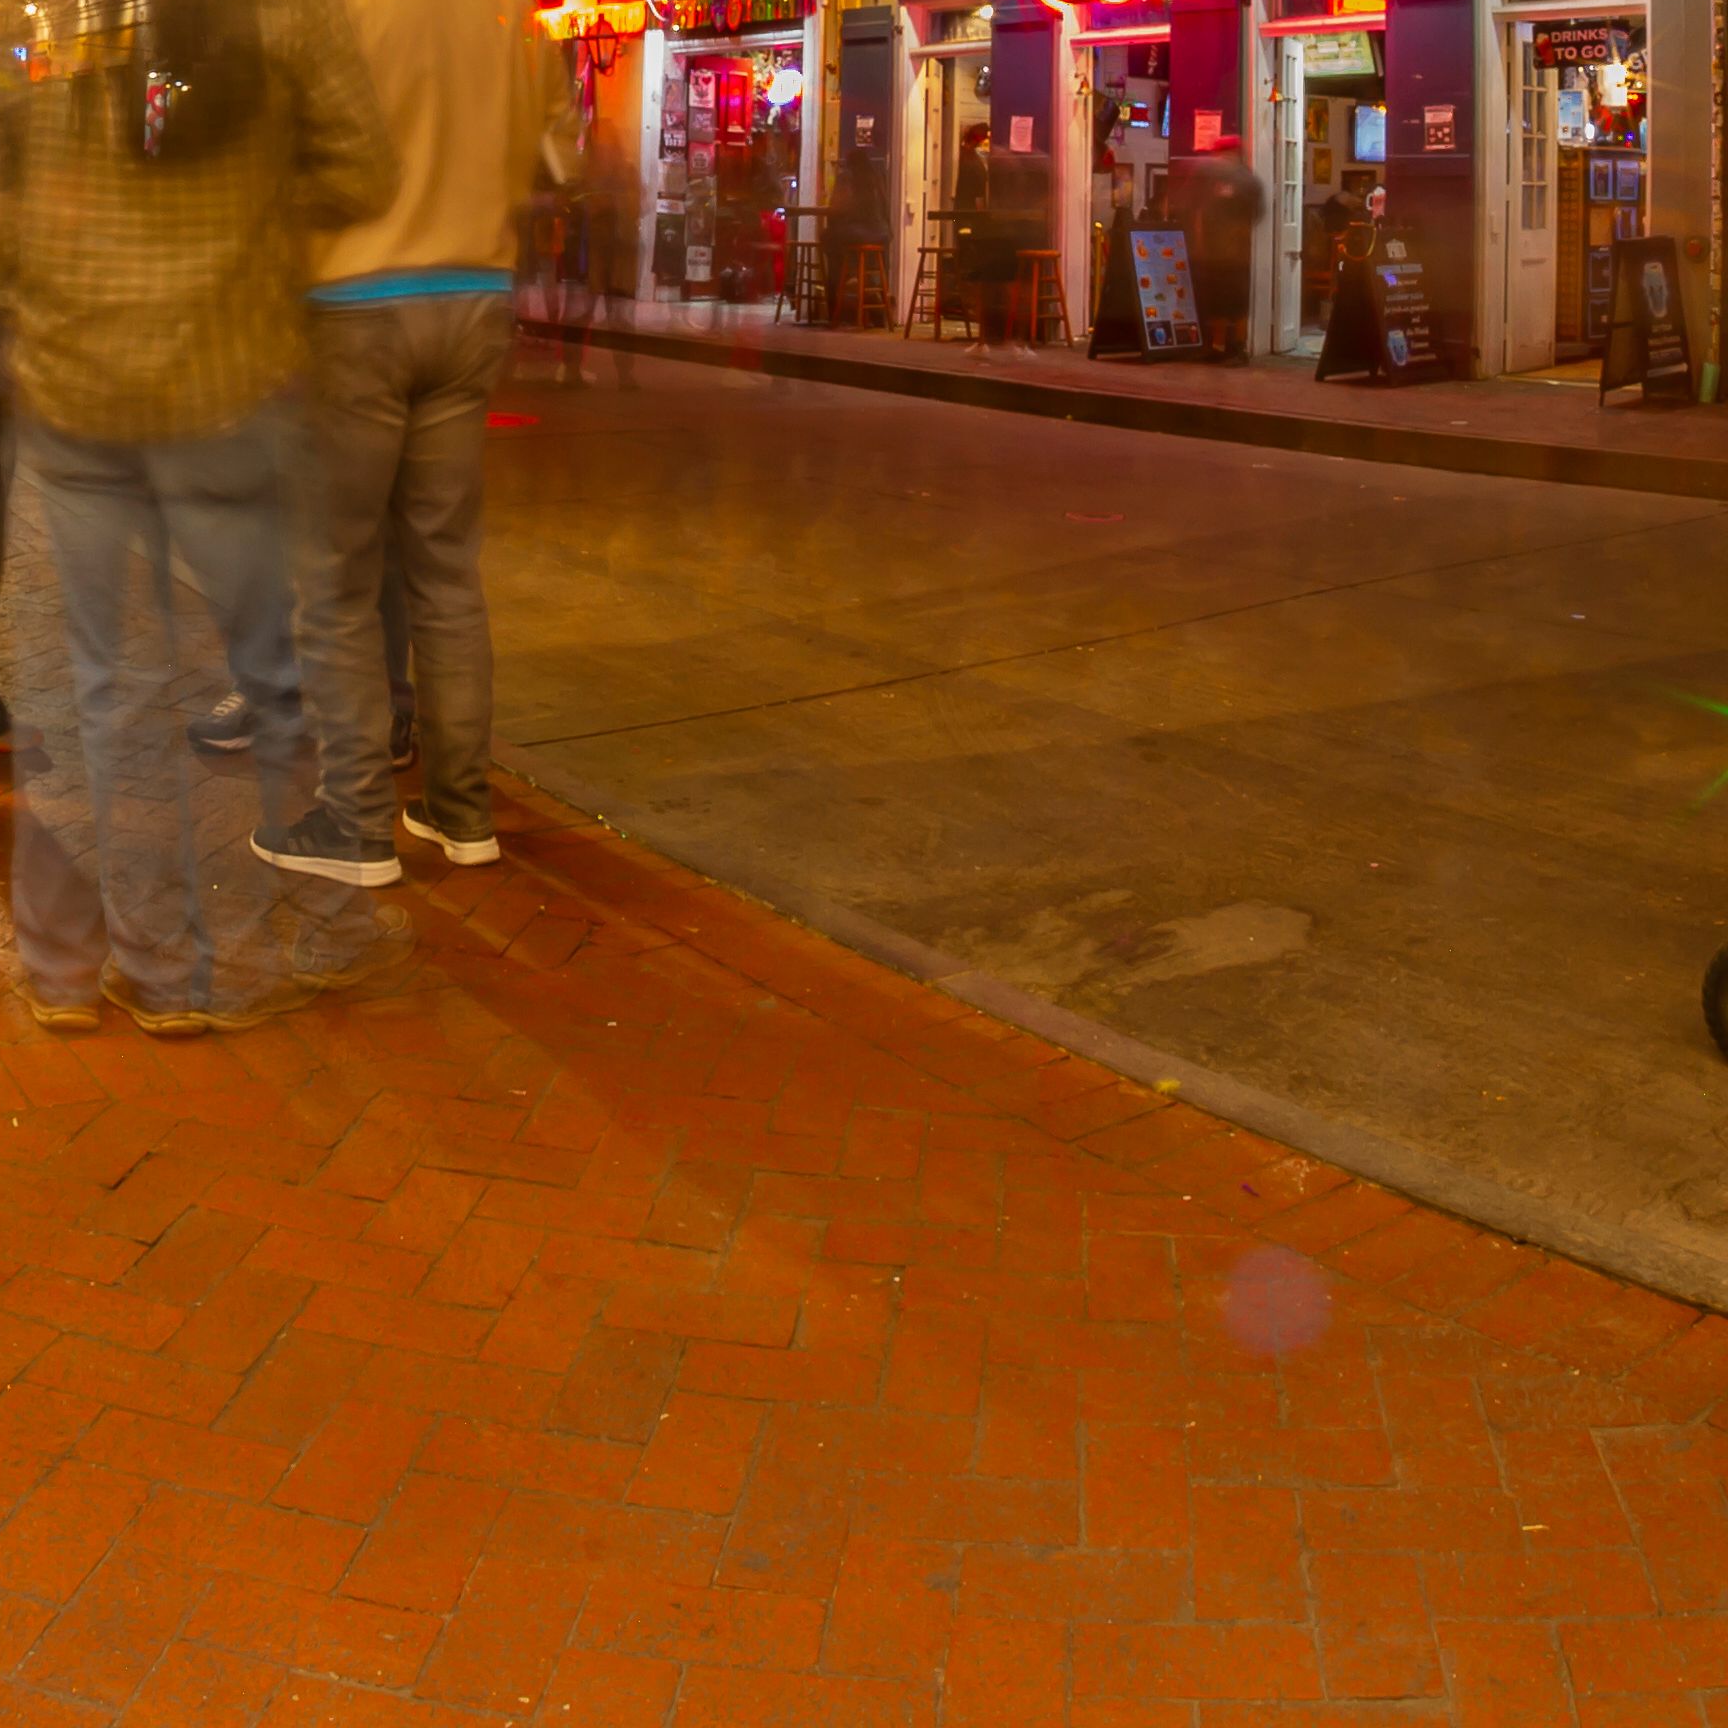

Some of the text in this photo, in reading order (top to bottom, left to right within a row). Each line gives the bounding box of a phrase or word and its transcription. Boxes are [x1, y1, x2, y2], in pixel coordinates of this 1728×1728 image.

[1551, 28, 1608, 43] DRINKS
[1554, 44, 1608, 61] TO GO
